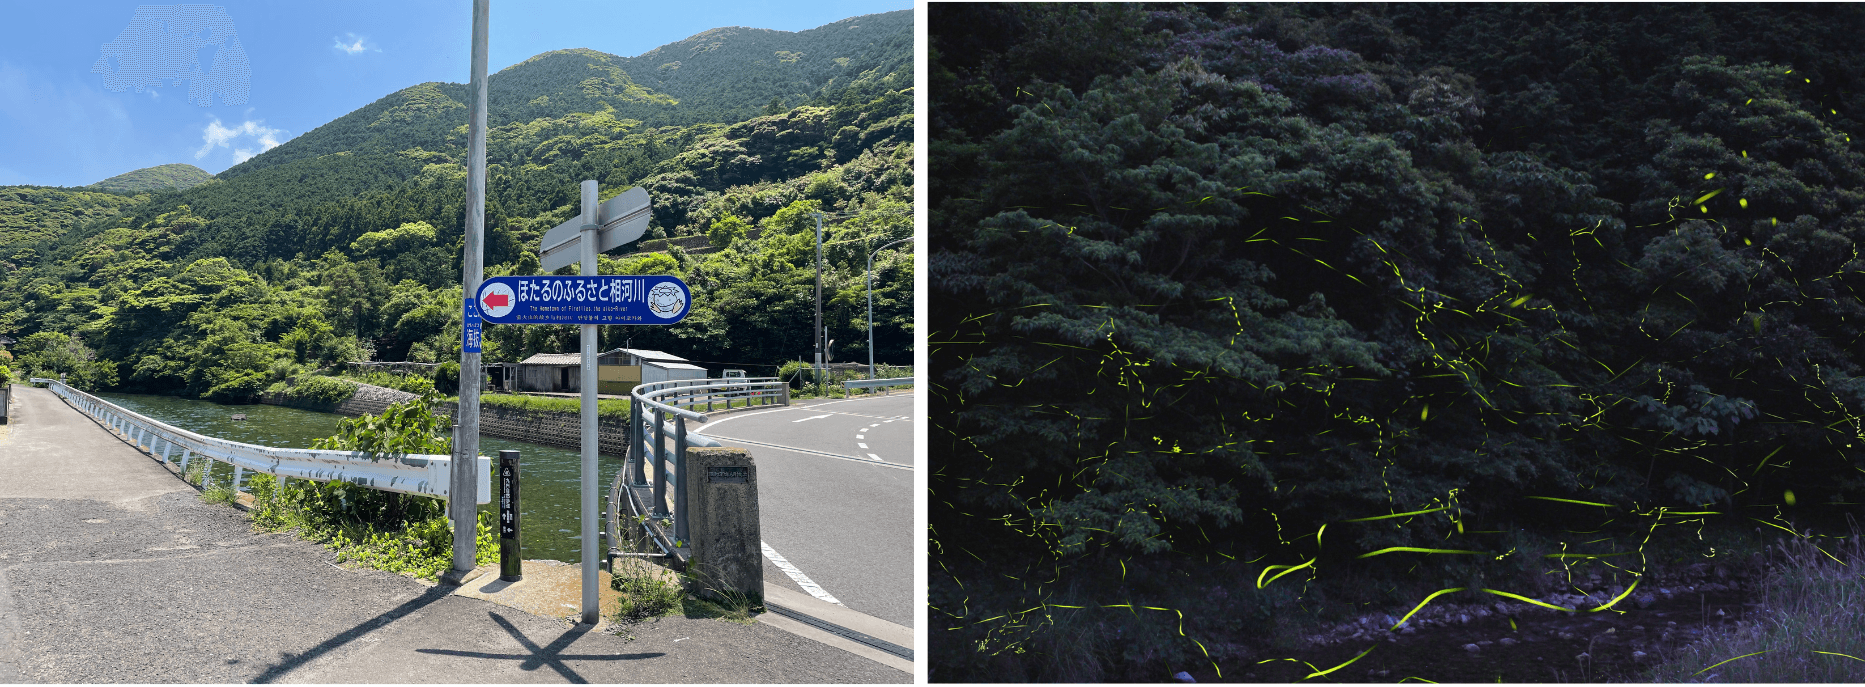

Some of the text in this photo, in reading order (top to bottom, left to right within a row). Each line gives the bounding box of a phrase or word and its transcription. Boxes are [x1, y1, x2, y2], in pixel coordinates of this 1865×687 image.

[518, 279, 645, 303] ほたるのふるさと相河川
